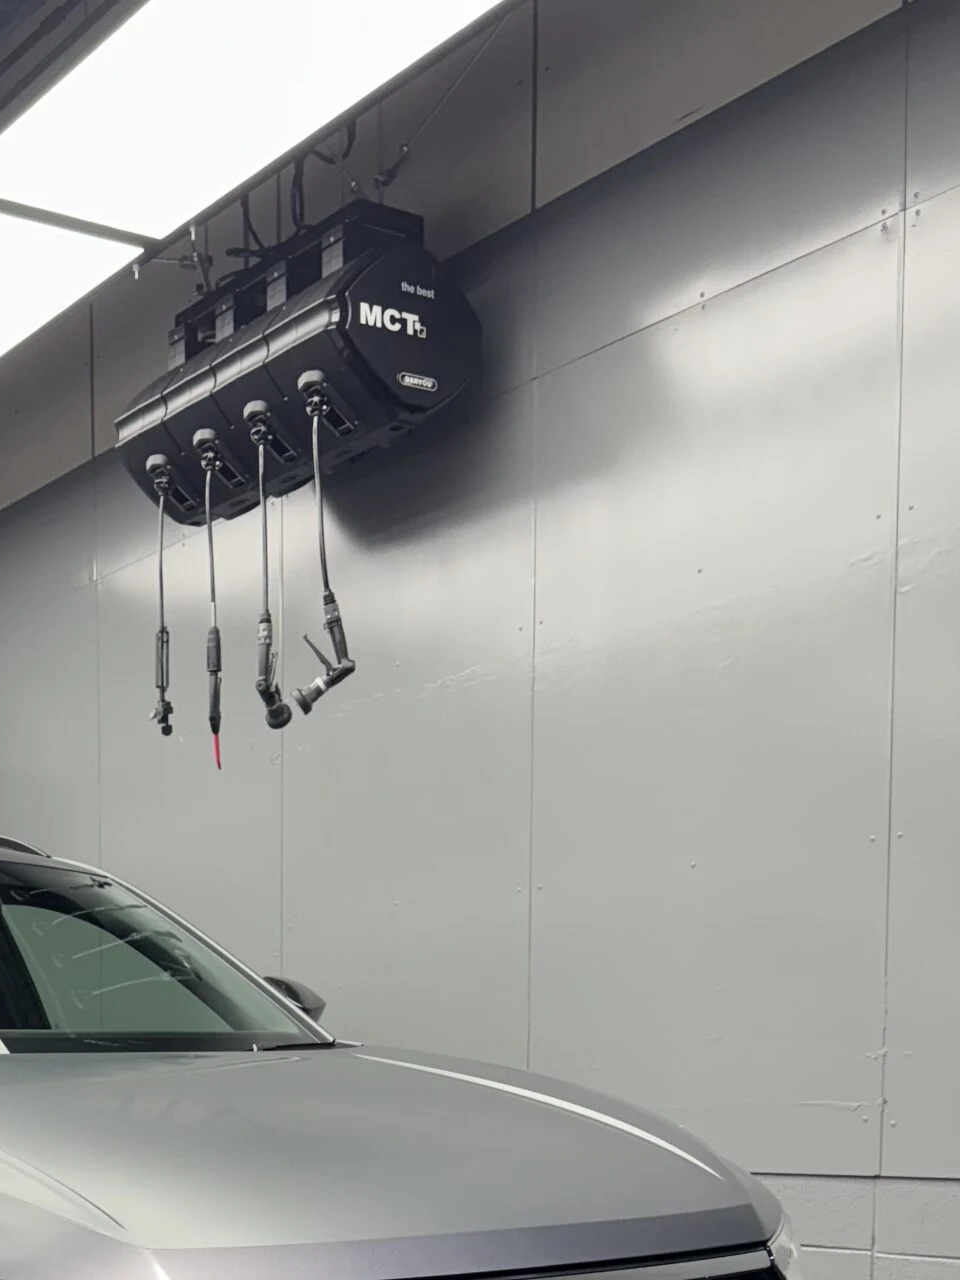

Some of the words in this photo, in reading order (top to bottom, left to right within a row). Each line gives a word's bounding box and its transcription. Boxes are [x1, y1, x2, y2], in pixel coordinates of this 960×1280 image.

[401, 281, 415, 293] the
[416, 285, 435, 299] best
[359, 302, 420, 336] MCT
